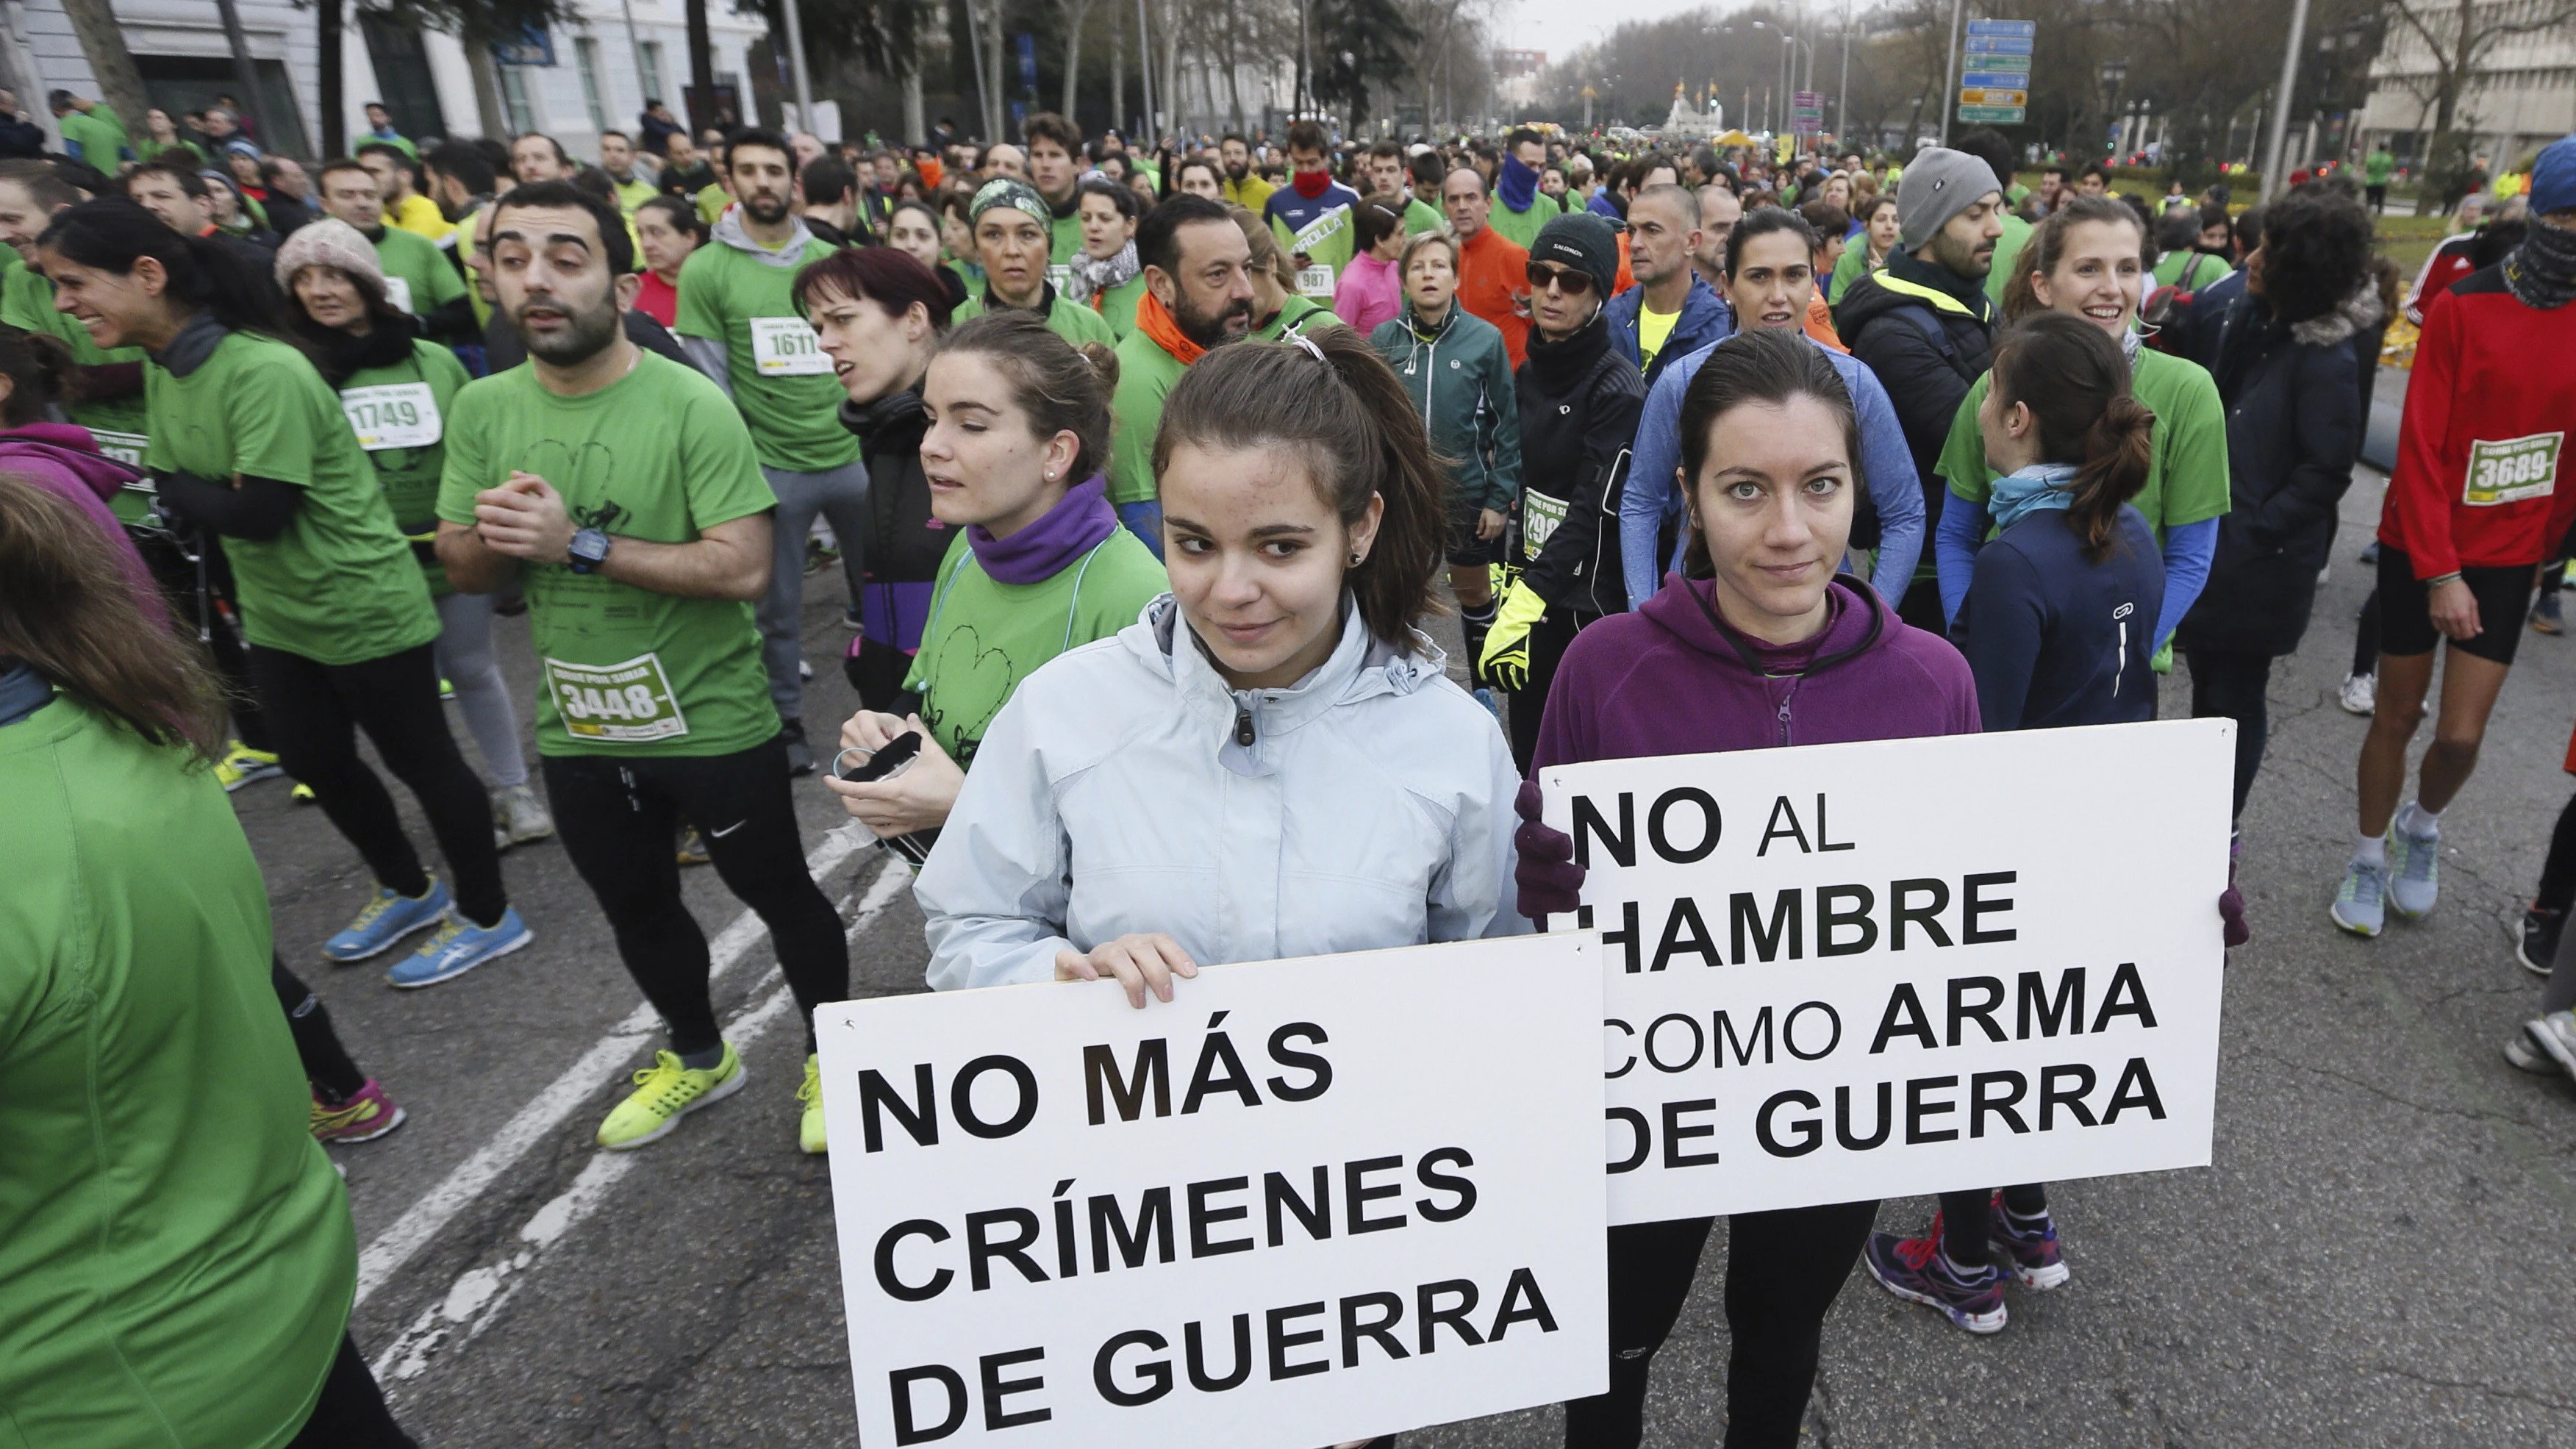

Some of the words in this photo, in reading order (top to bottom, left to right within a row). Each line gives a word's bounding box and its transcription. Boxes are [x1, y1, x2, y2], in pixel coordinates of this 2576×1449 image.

[1303, 273, 1324, 287] 987
[1553, 243, 1584, 257] SALOMON
[769, 334, 816, 356] 1611
[346, 402, 418, 429] 1749
[2475, 450, 2548, 488] 3689
[560, 684, 659, 720] 3448
[1572, 787, 1722, 870] NO
[1756, 793, 1856, 858] AL
[1869, 962, 2158, 1055] ARMA
[858, 1054, 1040, 1154] NO
[1082, 1010, 1334, 1127] MÁS
[1606, 1098, 1720, 1175] DE
[1756, 1057, 2167, 1159] GUERRA
[873, 1147, 1478, 1303] CRÍMENES
[889, 1346, 1053, 1448] DE
[1093, 1267, 1560, 1408] GUERRA
